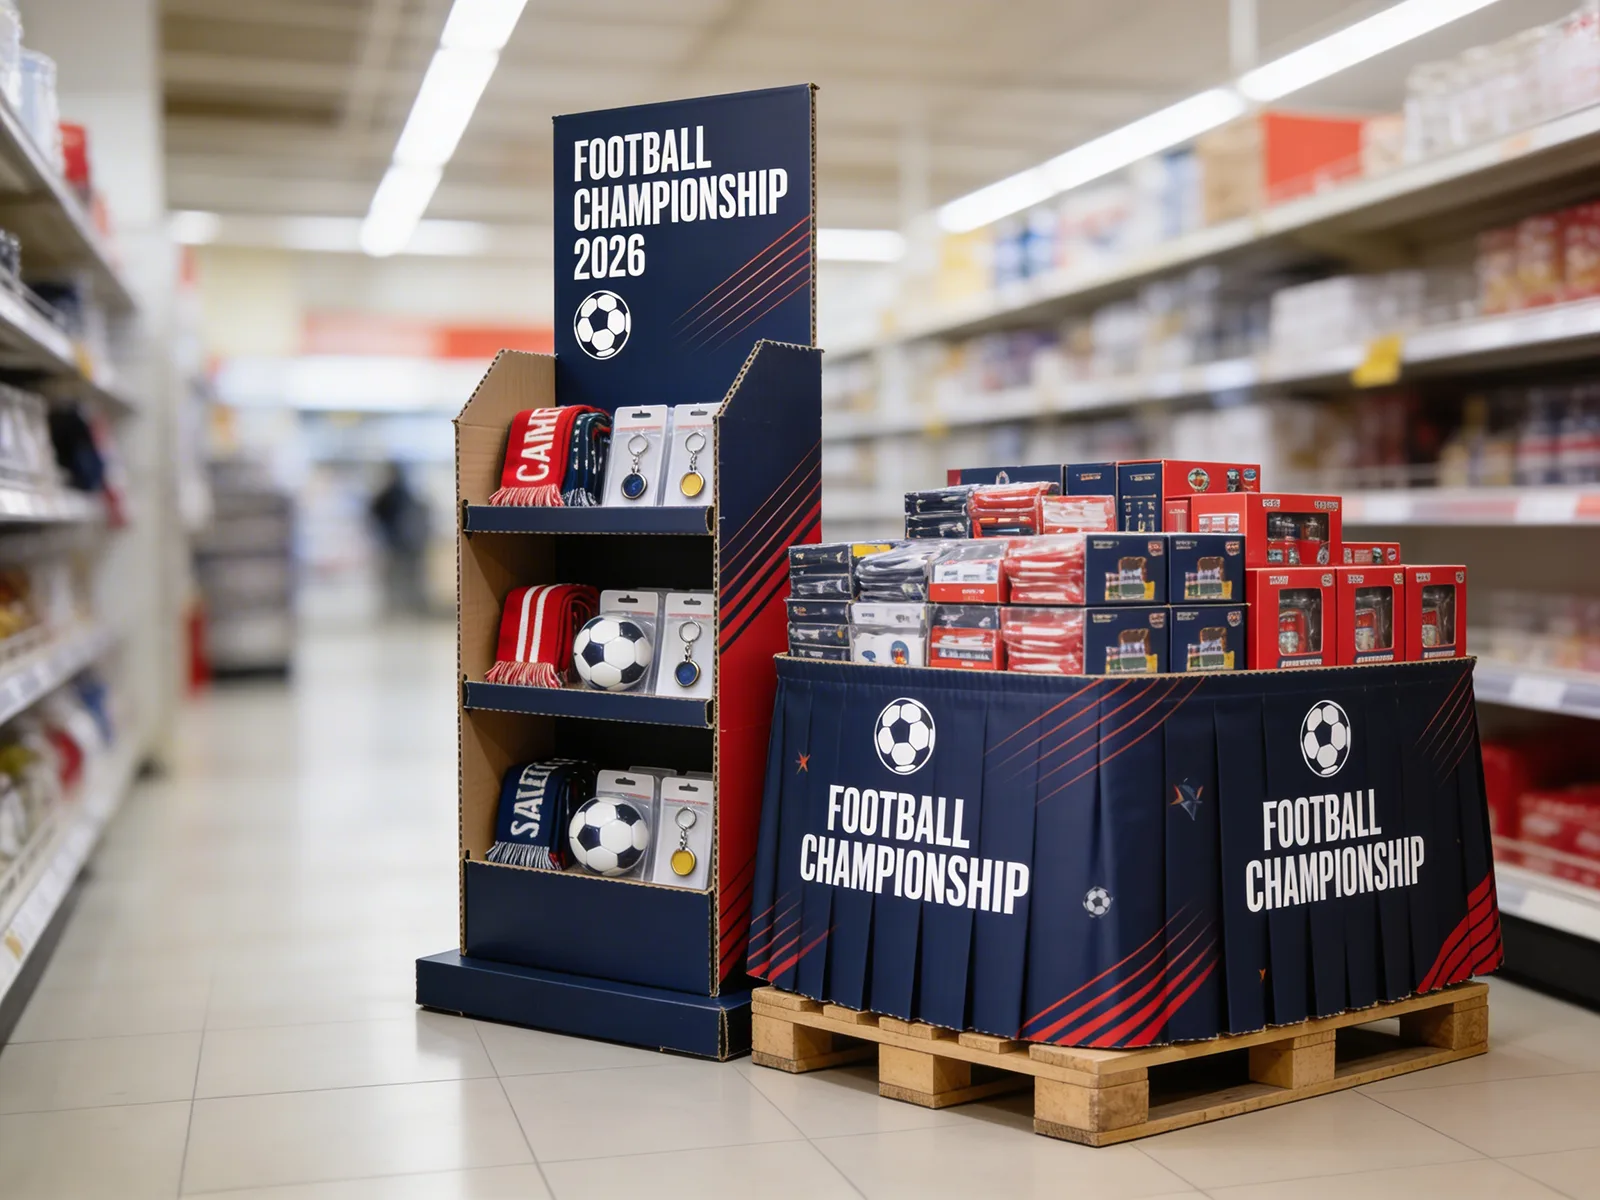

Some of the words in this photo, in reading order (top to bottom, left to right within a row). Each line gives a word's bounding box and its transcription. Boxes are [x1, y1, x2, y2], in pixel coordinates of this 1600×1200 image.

[574, 125, 712, 182] FOOTBALL
[573, 168, 788, 232] CHAMPIONSHIP
[573, 233, 646, 281] 2026
[827, 784, 970, 849] FOOTBALL
[1262, 788, 1382, 851] FOOTBALL
[800, 833, 1030, 915] CHAMPIONSHIP
[1245, 835, 1425, 913] CHAMPIONSHIP
